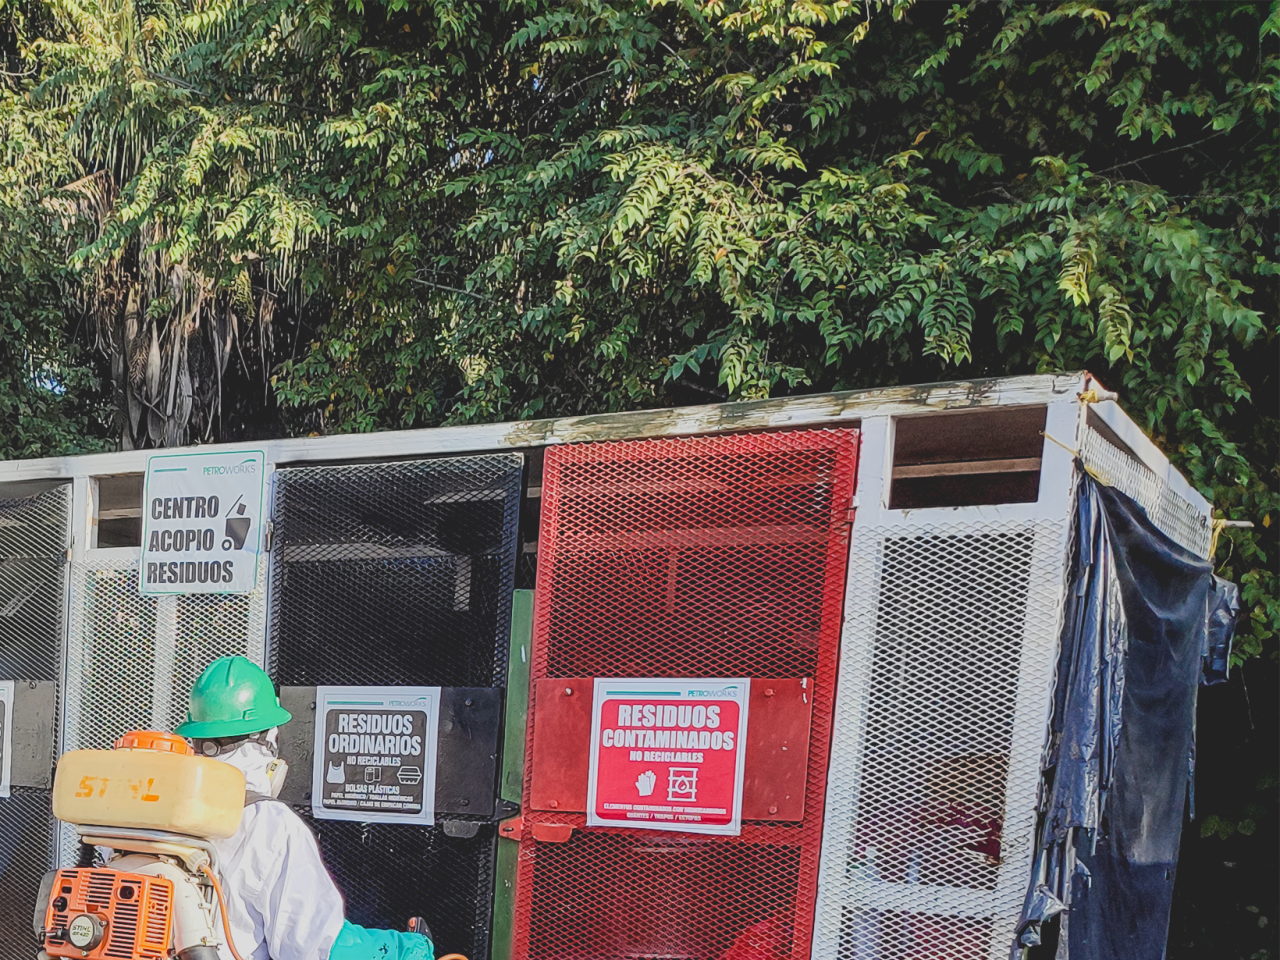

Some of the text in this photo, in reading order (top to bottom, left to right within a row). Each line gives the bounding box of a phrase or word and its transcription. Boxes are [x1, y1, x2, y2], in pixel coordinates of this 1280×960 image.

[203, 464, 256, 476] PETROWORKS
[151, 496, 220, 520] CENTRO
[148, 529, 215, 552] ACOPIO
[147, 560, 234, 584] RESIDUOS
[687, 689, 738, 698] PETROWORKS
[338, 713, 414, 735] RESIDUOS
[618, 704, 721, 729] RESIDUOS
[328, 734, 422, 756] ORDINARIOS
[602, 729, 735, 751] CONTAMINADOS
[346, 756, 402, 767] NO RECICLABLES
[629, 751, 704, 763] NO RECICLABLES
[345, 783, 400, 794] BOLSAS PLÁSTICAS
